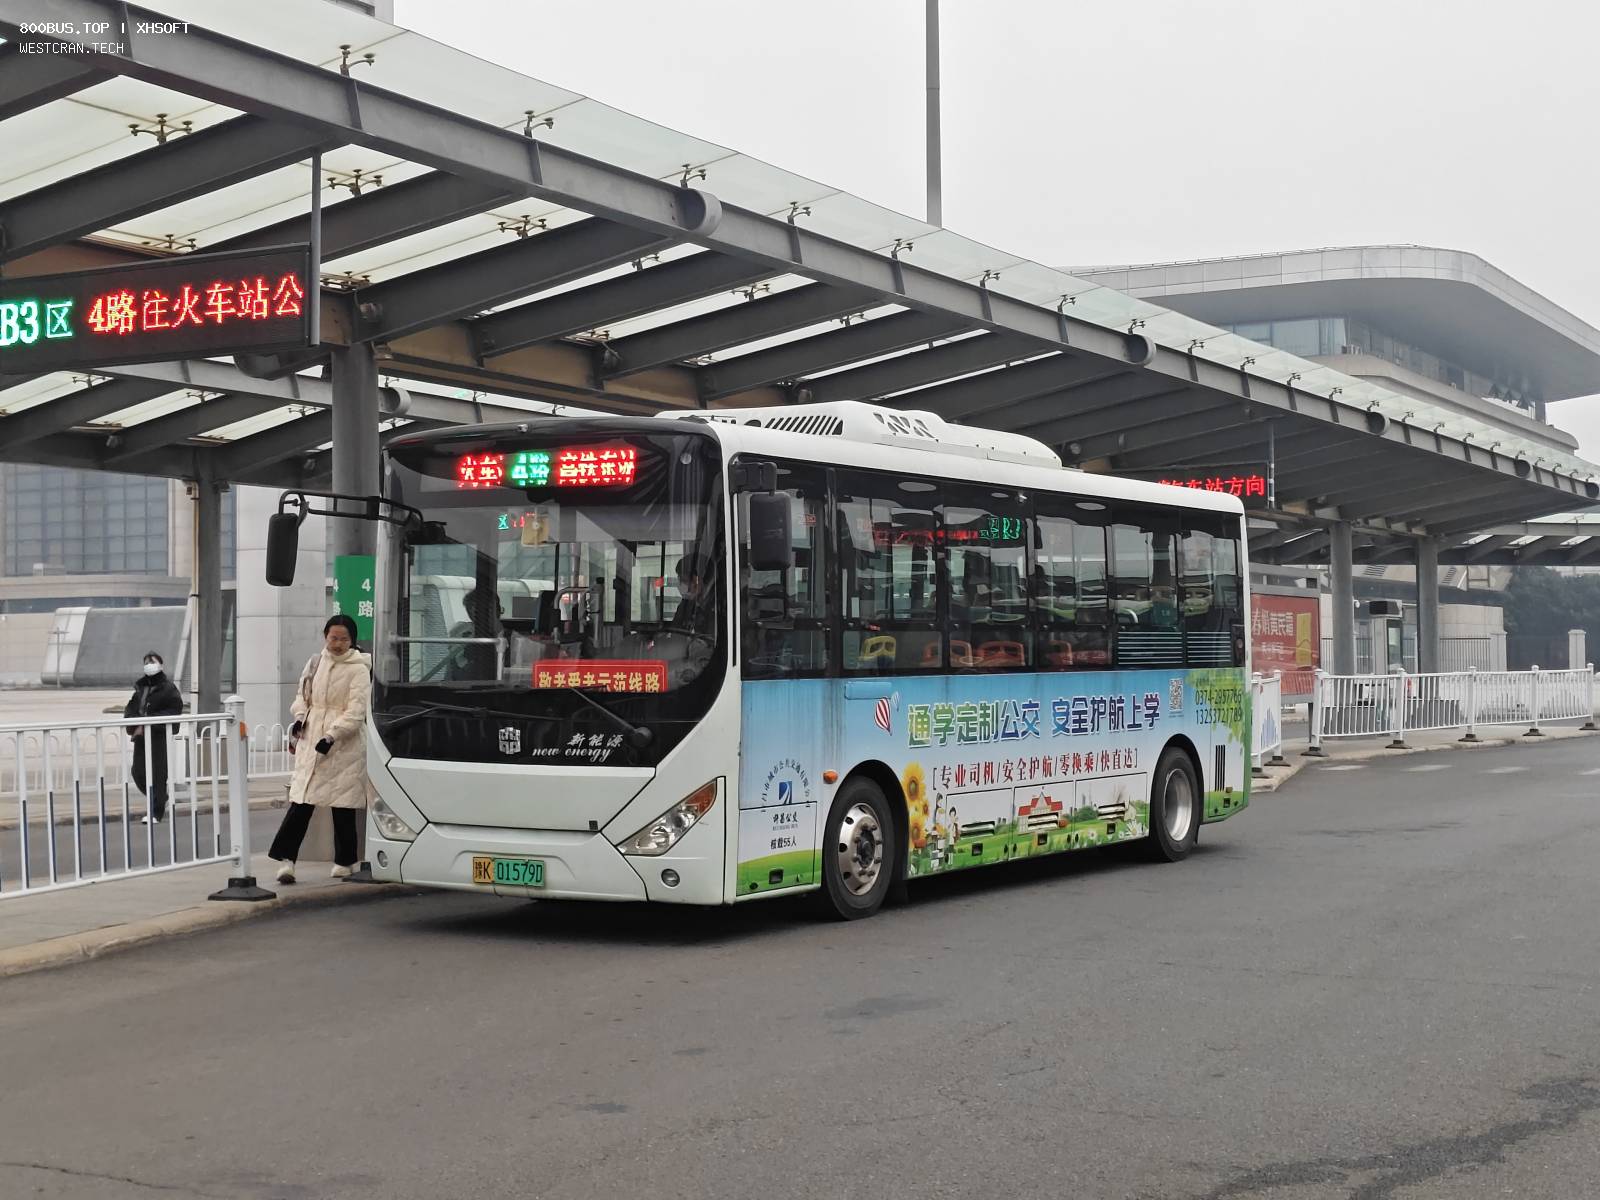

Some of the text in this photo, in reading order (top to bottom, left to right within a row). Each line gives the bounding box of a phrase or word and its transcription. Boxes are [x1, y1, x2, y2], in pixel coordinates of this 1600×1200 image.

[908, 692, 1161, 748] 通学定制公交 安全护航上学
[567, 733, 624, 748] 新能源
[532, 747, 611, 762] new energy
